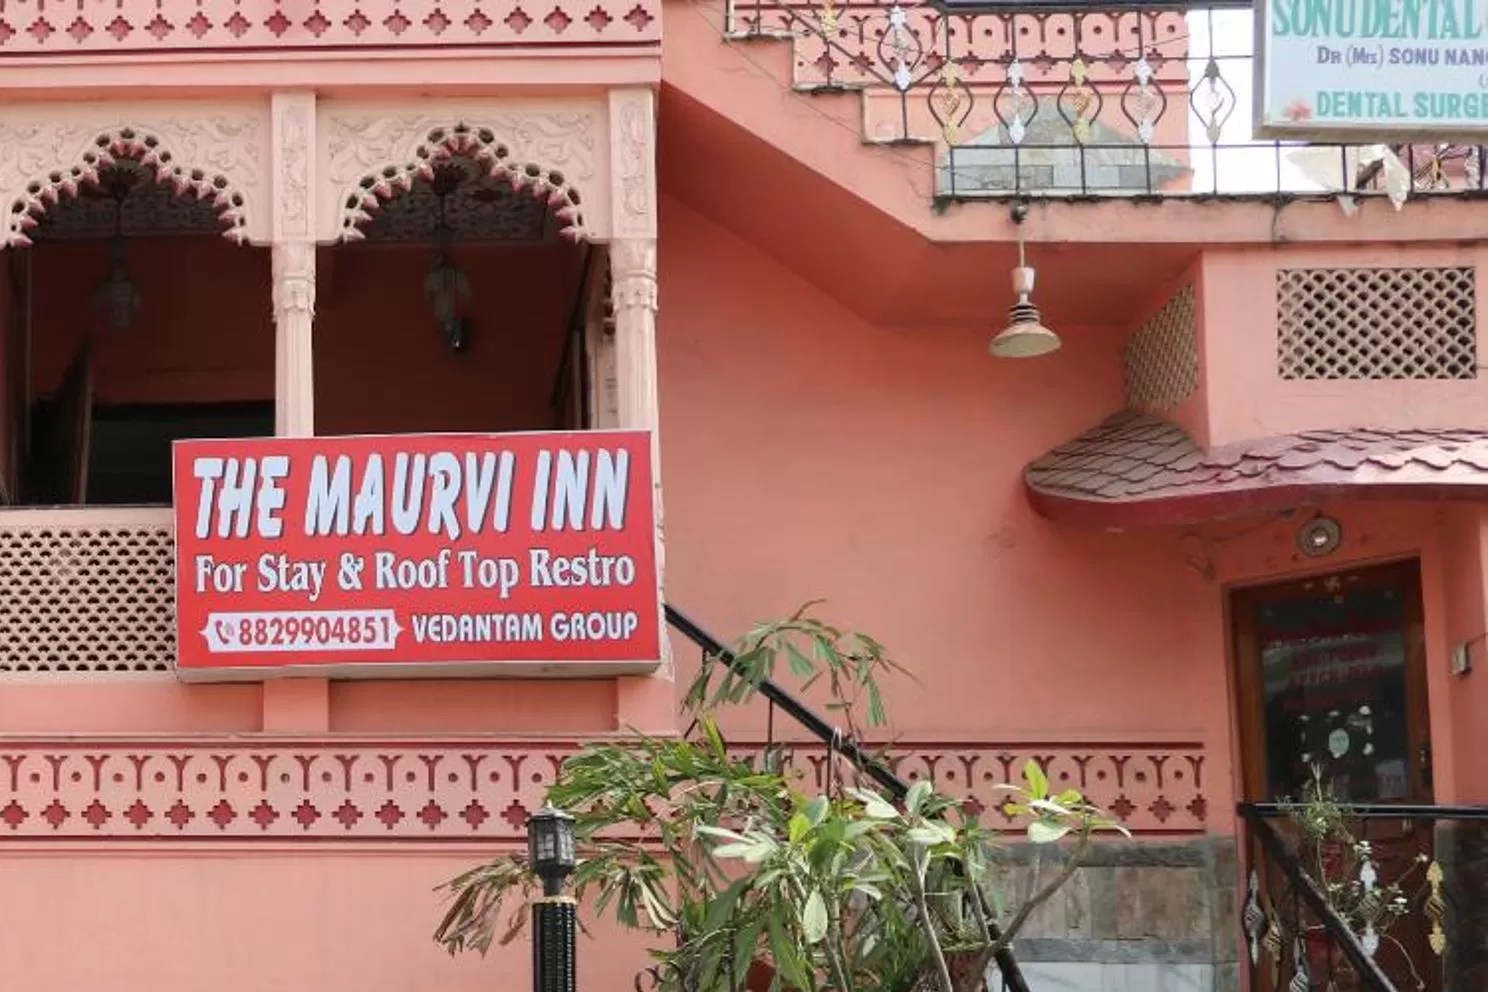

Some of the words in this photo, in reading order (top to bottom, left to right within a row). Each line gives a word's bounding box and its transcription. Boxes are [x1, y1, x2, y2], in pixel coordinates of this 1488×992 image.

[1273, 0, 1356, 37] SONU
[1362, 0, 1482, 40] DENTAL
[1389, 48, 1440, 65] SONU
[1444, 48, 1488, 66] NAN
[1316, 91, 1408, 118] DENTAL
[194, 456, 290, 538] THE
[305, 449, 515, 540] MAURVI
[531, 447, 630, 533] INN
[196, 555, 247, 593] For
[257, 553, 326, 601] Stay
[338, 555, 363, 588] &
[376, 549, 452, 589] Roof
[458, 550, 519, 596] Top
[530, 547, 635, 587] Restro
[239, 616, 391, 645] 8829904851
[412, 613, 543, 642] VEDANTAM
[551, 612, 638, 640] GROUP
